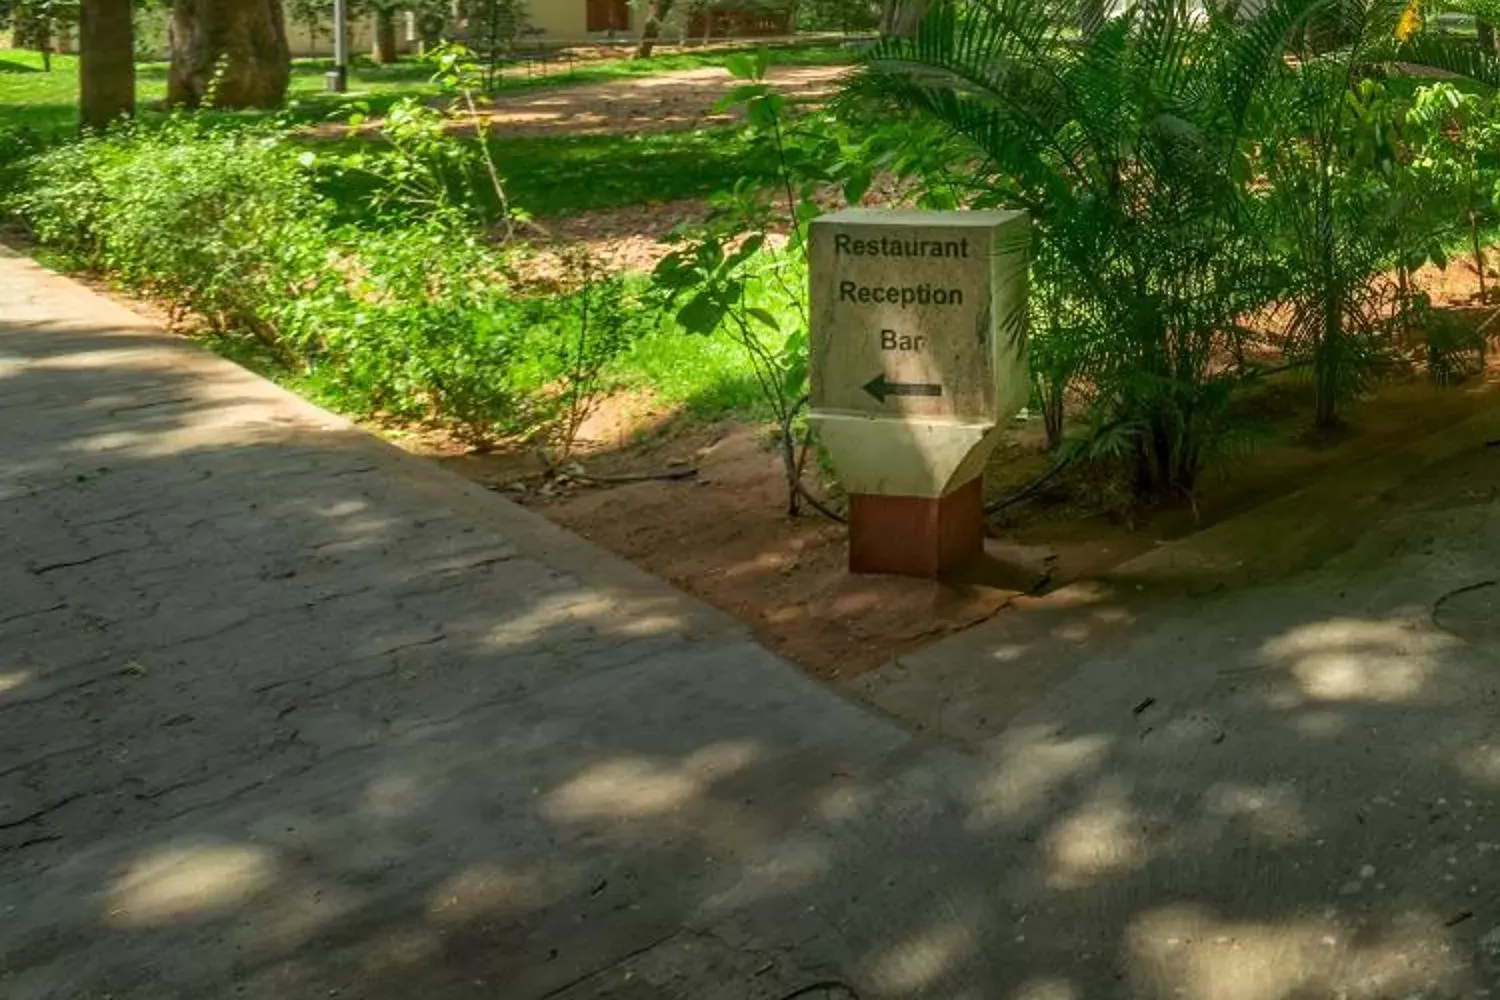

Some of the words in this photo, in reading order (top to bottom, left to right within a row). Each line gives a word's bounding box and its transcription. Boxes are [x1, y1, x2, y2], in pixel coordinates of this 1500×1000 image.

[834, 233, 969, 258] Restaurant
[839, 281, 963, 308] Reception
[881, 329, 924, 351] Bar
